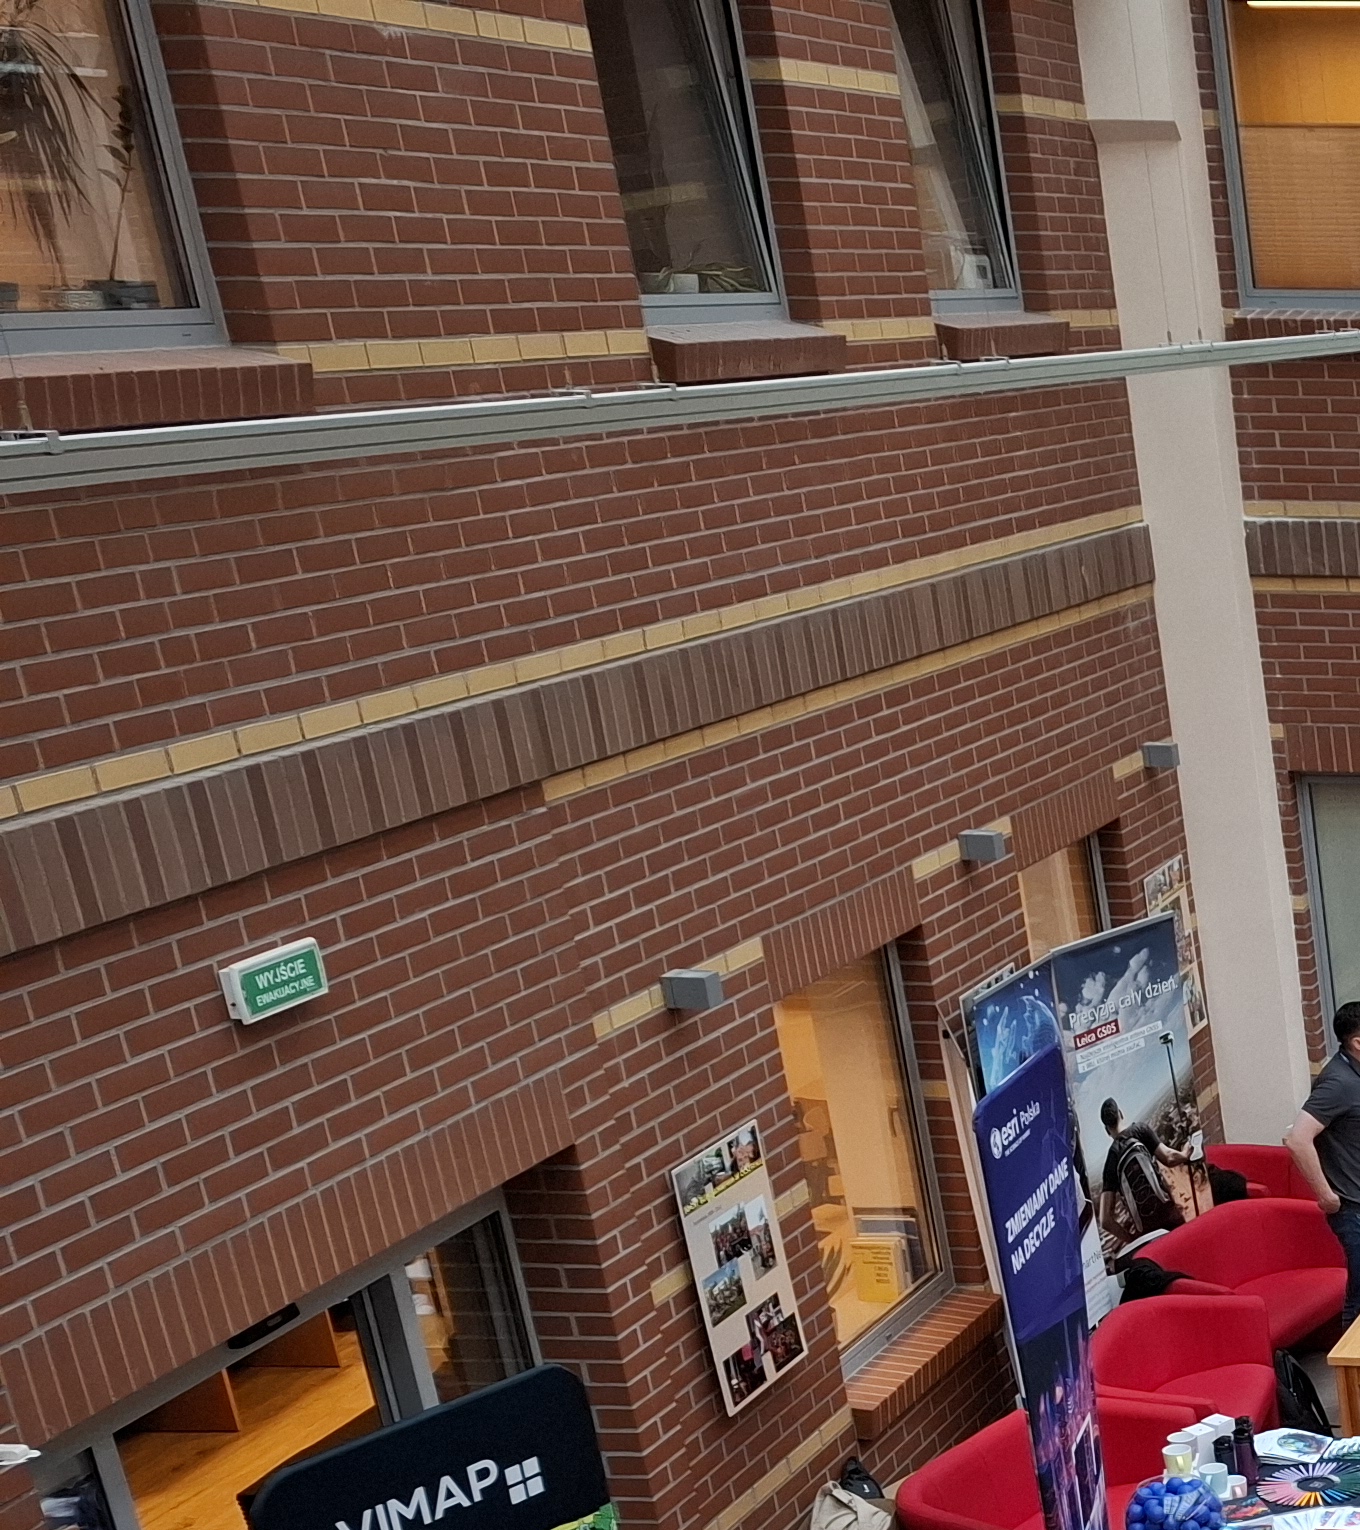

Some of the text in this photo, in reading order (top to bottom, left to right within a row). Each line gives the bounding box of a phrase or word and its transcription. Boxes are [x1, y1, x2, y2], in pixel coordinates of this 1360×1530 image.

[255, 958, 307, 990] WYJŚCIE
[256, 975, 316, 1007] EWAKUACYJNE
[1068, 975, 1178, 1029] Precyzja cały dzień.
[1076, 1031, 1096, 1048] Leica
[1096, 1021, 1117, 1038] GS05
[1001, 1108, 1020, 1146] esri
[1020, 1099, 1041, 1129] Polska
[1005, 1177, 1049, 1244] ZMIENIAMY
[1048, 1156, 1069, 1195] DANE
[1011, 1206, 1056, 1275] NA DECYZJE
